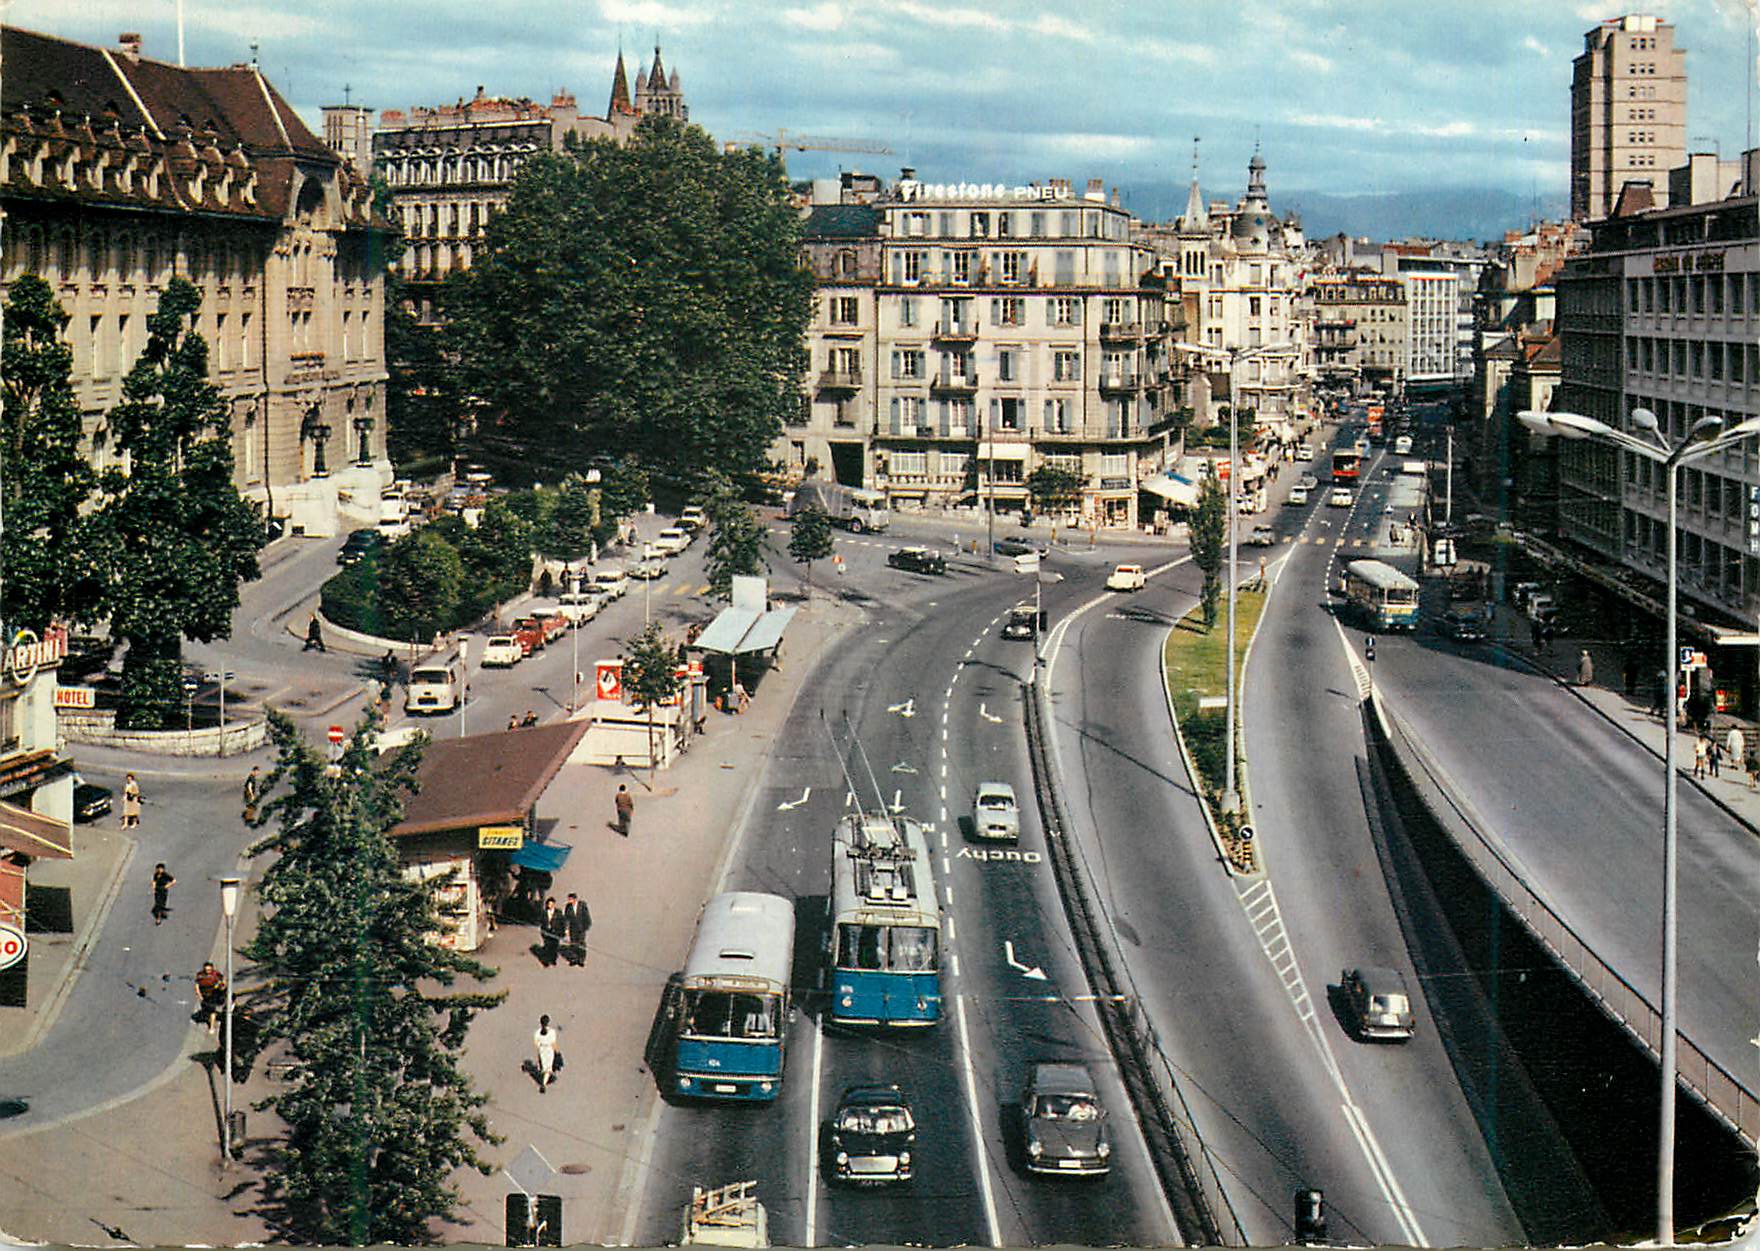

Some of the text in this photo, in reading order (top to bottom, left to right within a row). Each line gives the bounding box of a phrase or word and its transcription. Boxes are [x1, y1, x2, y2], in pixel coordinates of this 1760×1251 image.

[900, 180, 1005, 201] Firestone
[3, 638, 60, 673] ARTINI
[56, 690, 89, 705] HOTEL
[956, 847, 1042, 863] Ouchy
